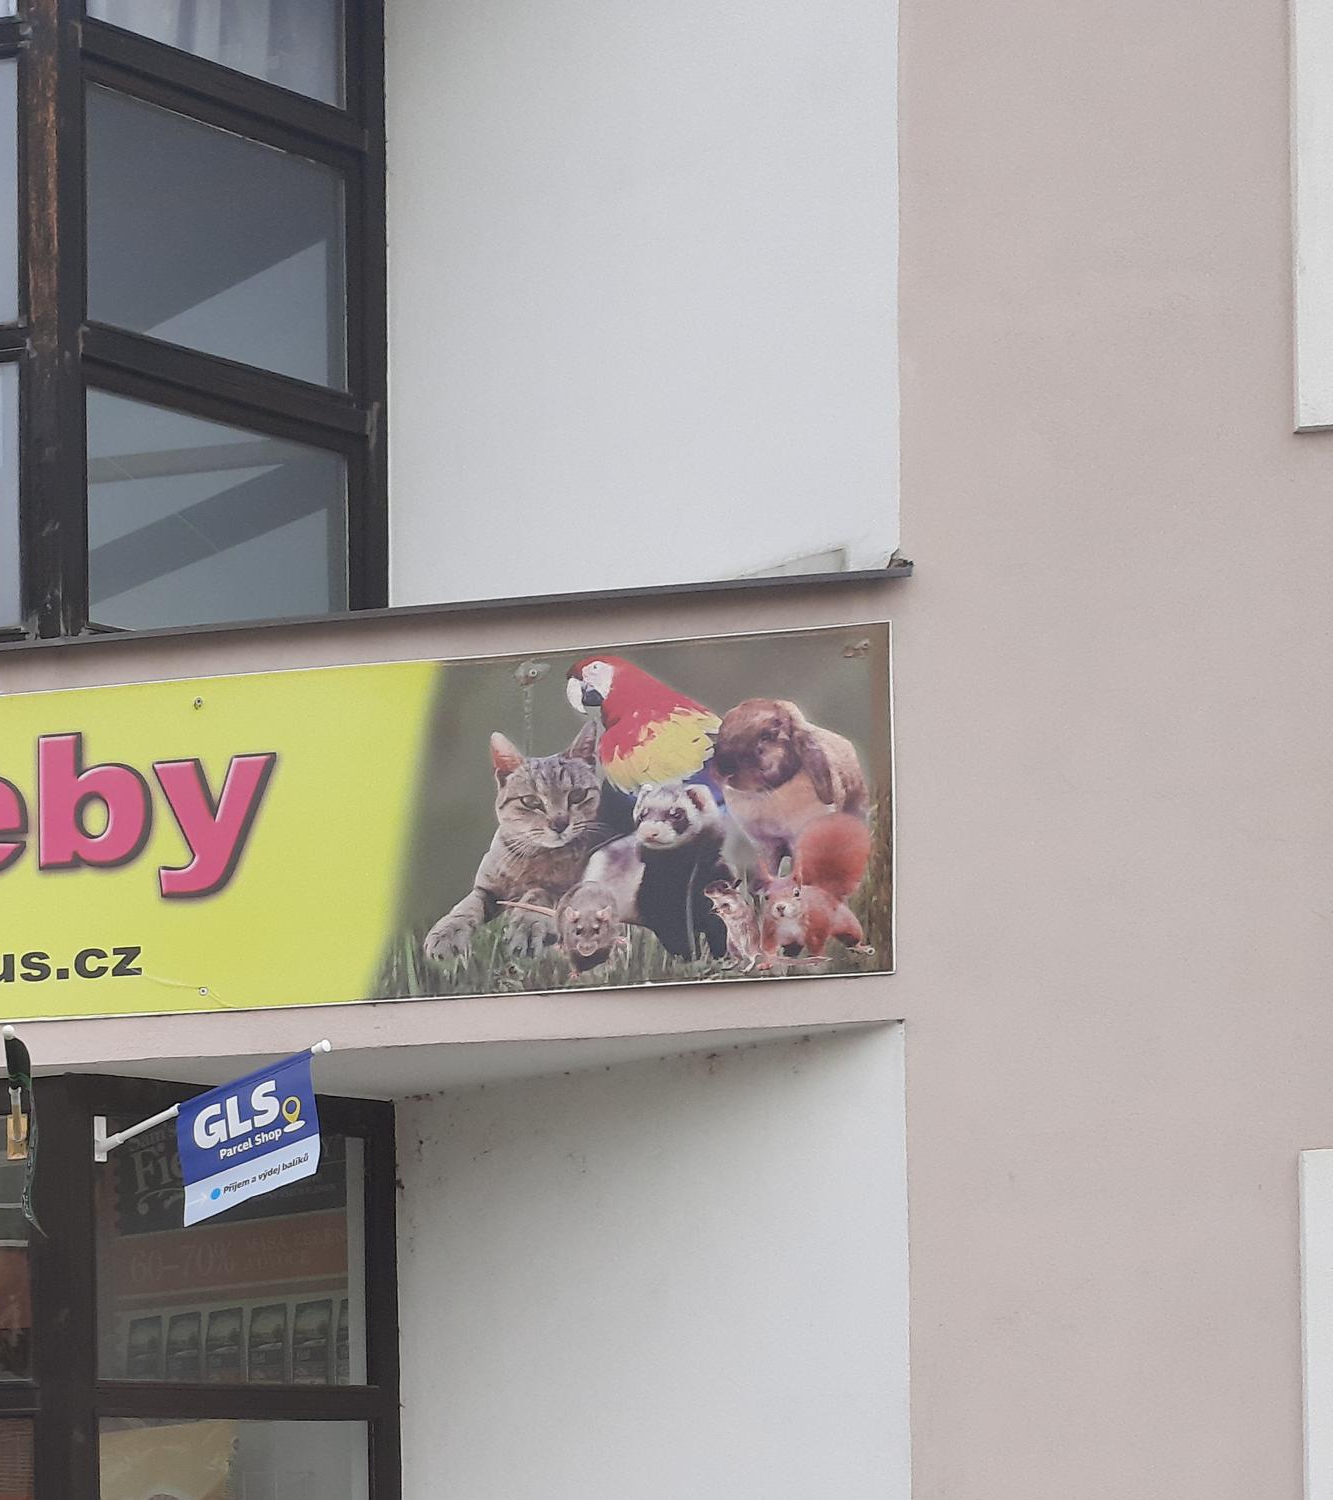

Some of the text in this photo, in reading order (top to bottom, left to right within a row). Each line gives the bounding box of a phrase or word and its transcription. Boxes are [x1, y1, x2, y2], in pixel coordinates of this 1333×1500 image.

[193, 1079, 280, 1149] GLS
[219, 1128, 282, 1160] Parcel Shop
[258, 1164, 281, 1180] výdej
